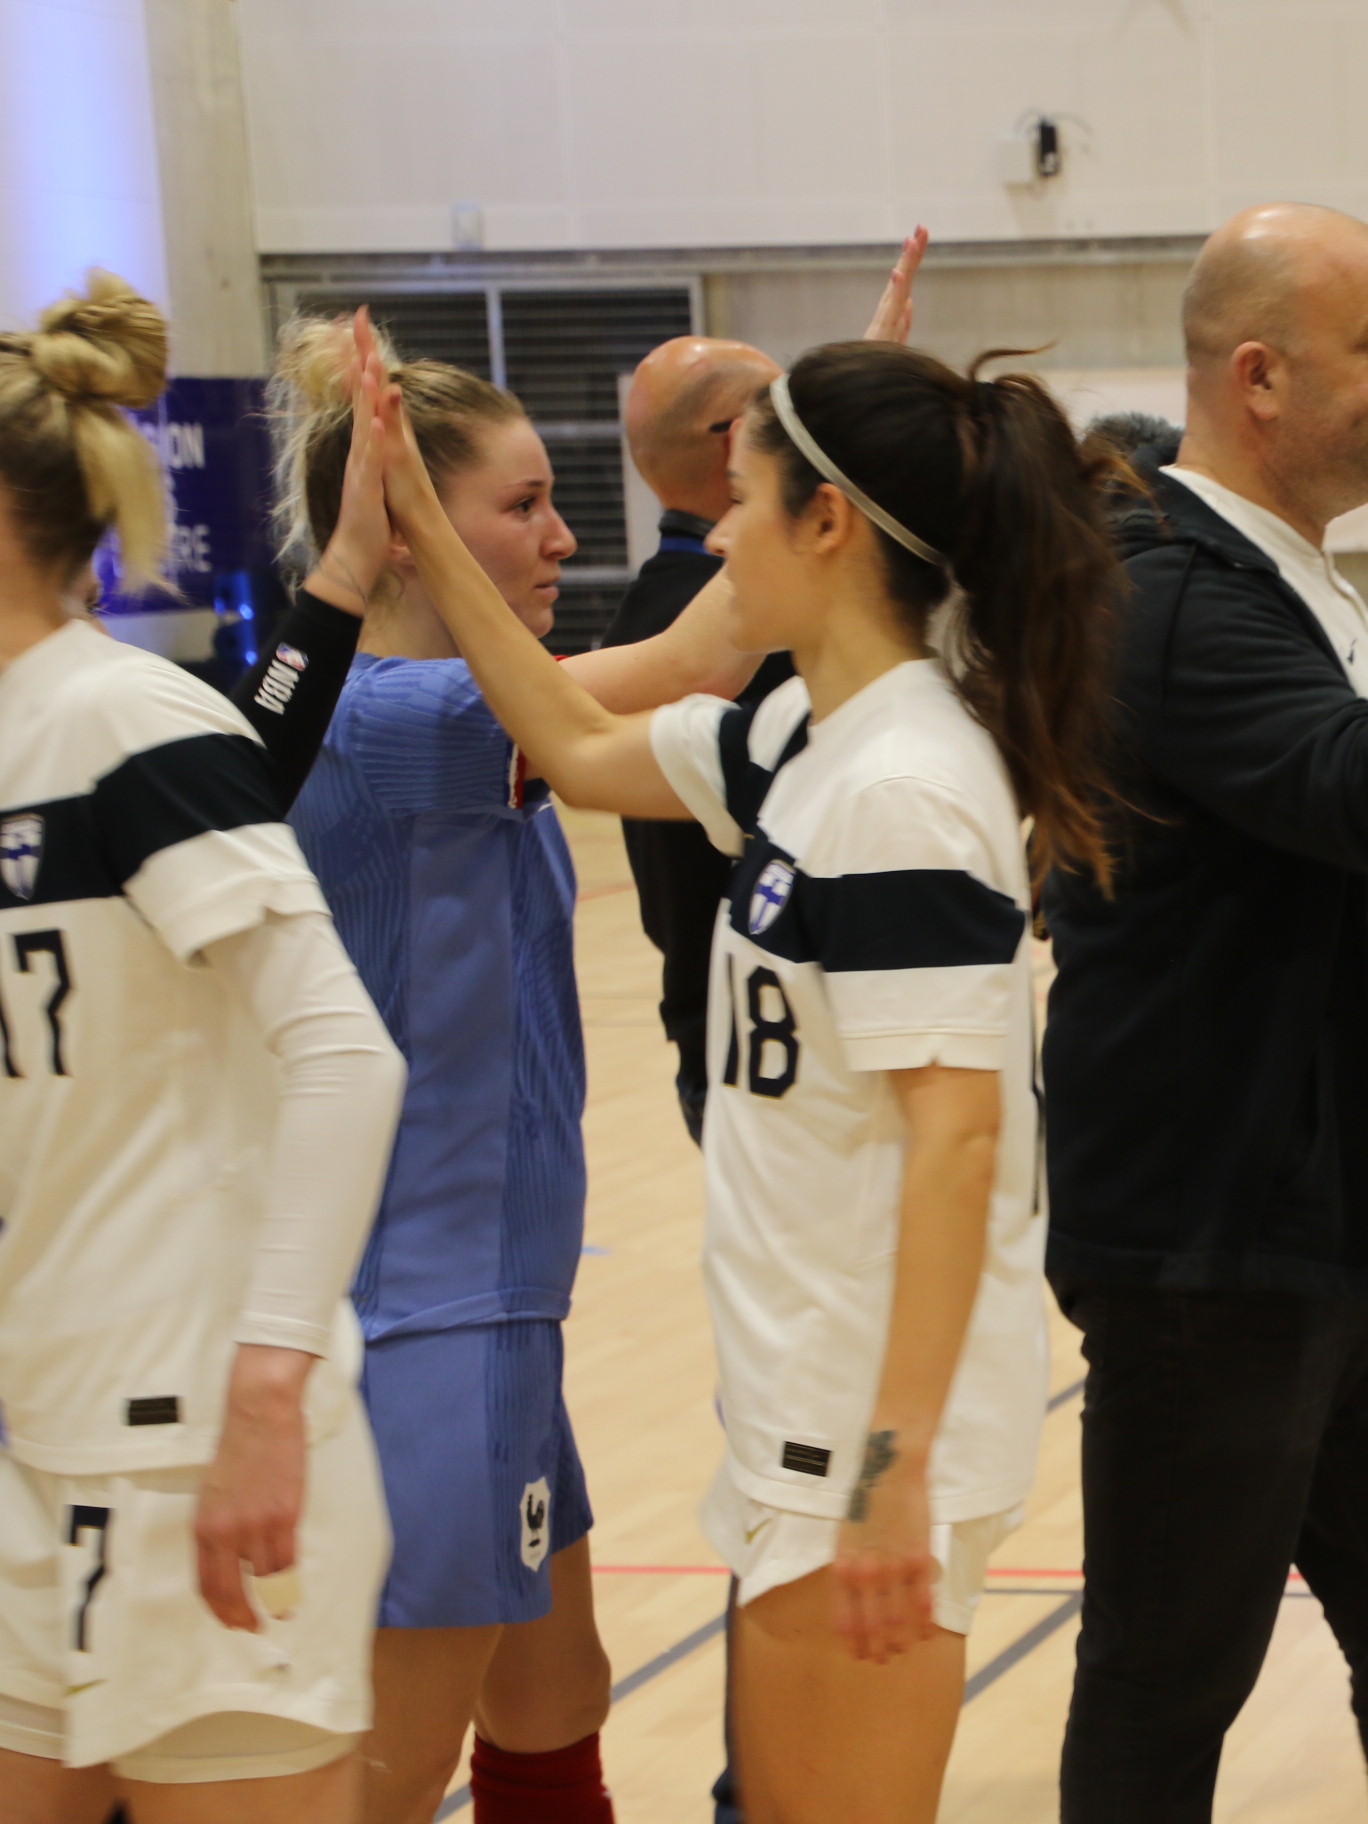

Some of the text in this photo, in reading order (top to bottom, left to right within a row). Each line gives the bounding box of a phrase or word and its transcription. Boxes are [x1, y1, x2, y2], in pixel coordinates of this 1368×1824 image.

[253, 658, 300, 716] NBA
[721, 951, 802, 1100] 18
[65, 1503, 112, 1654] 7
